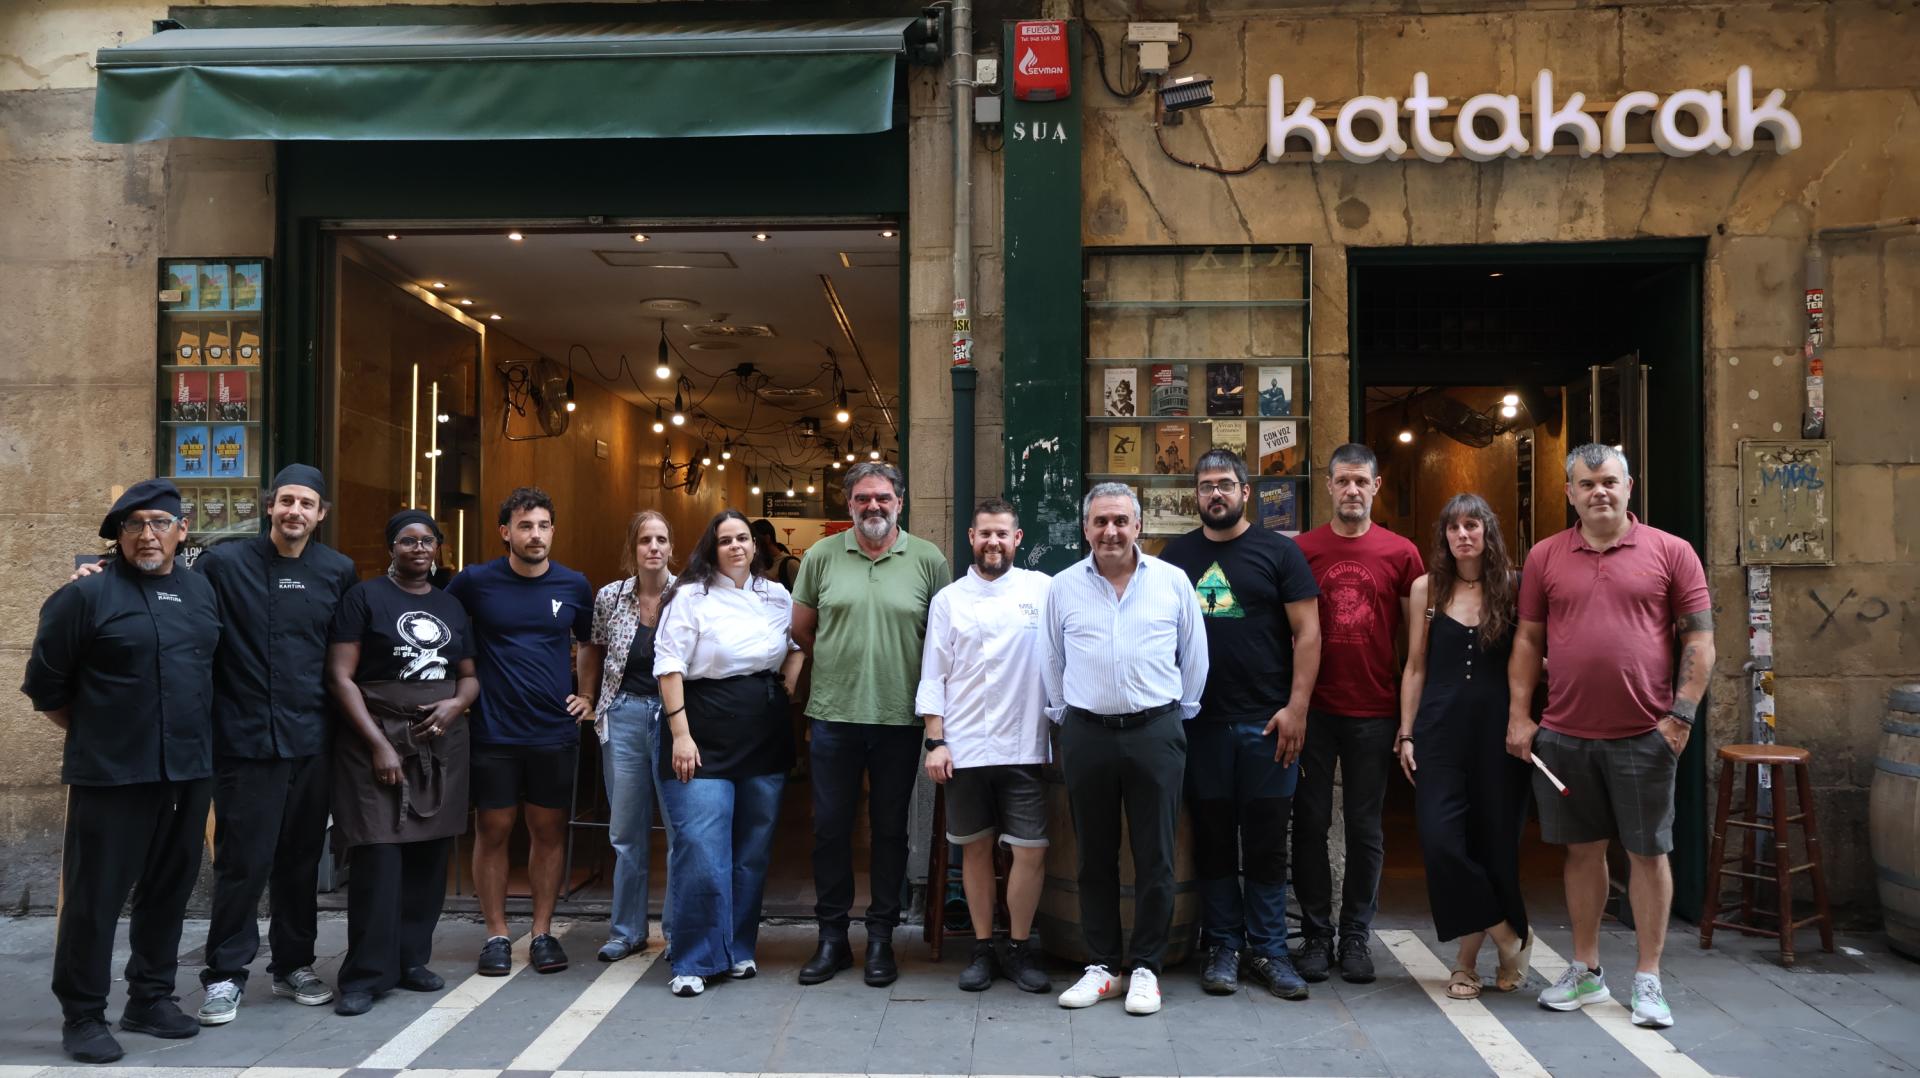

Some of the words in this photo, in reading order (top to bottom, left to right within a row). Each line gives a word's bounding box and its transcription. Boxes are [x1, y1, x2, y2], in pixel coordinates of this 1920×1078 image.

[1028, 66, 1064, 75] SEYMAN
[1267, 65, 1801, 163] katakrak
[1012, 121, 1068, 144] SUA
[1263, 430, 1278, 442] CON
[1277, 426, 1291, 437] VOZ
[1266, 441, 1272, 449] Y
[1272, 435, 1289, 447] VOTO
